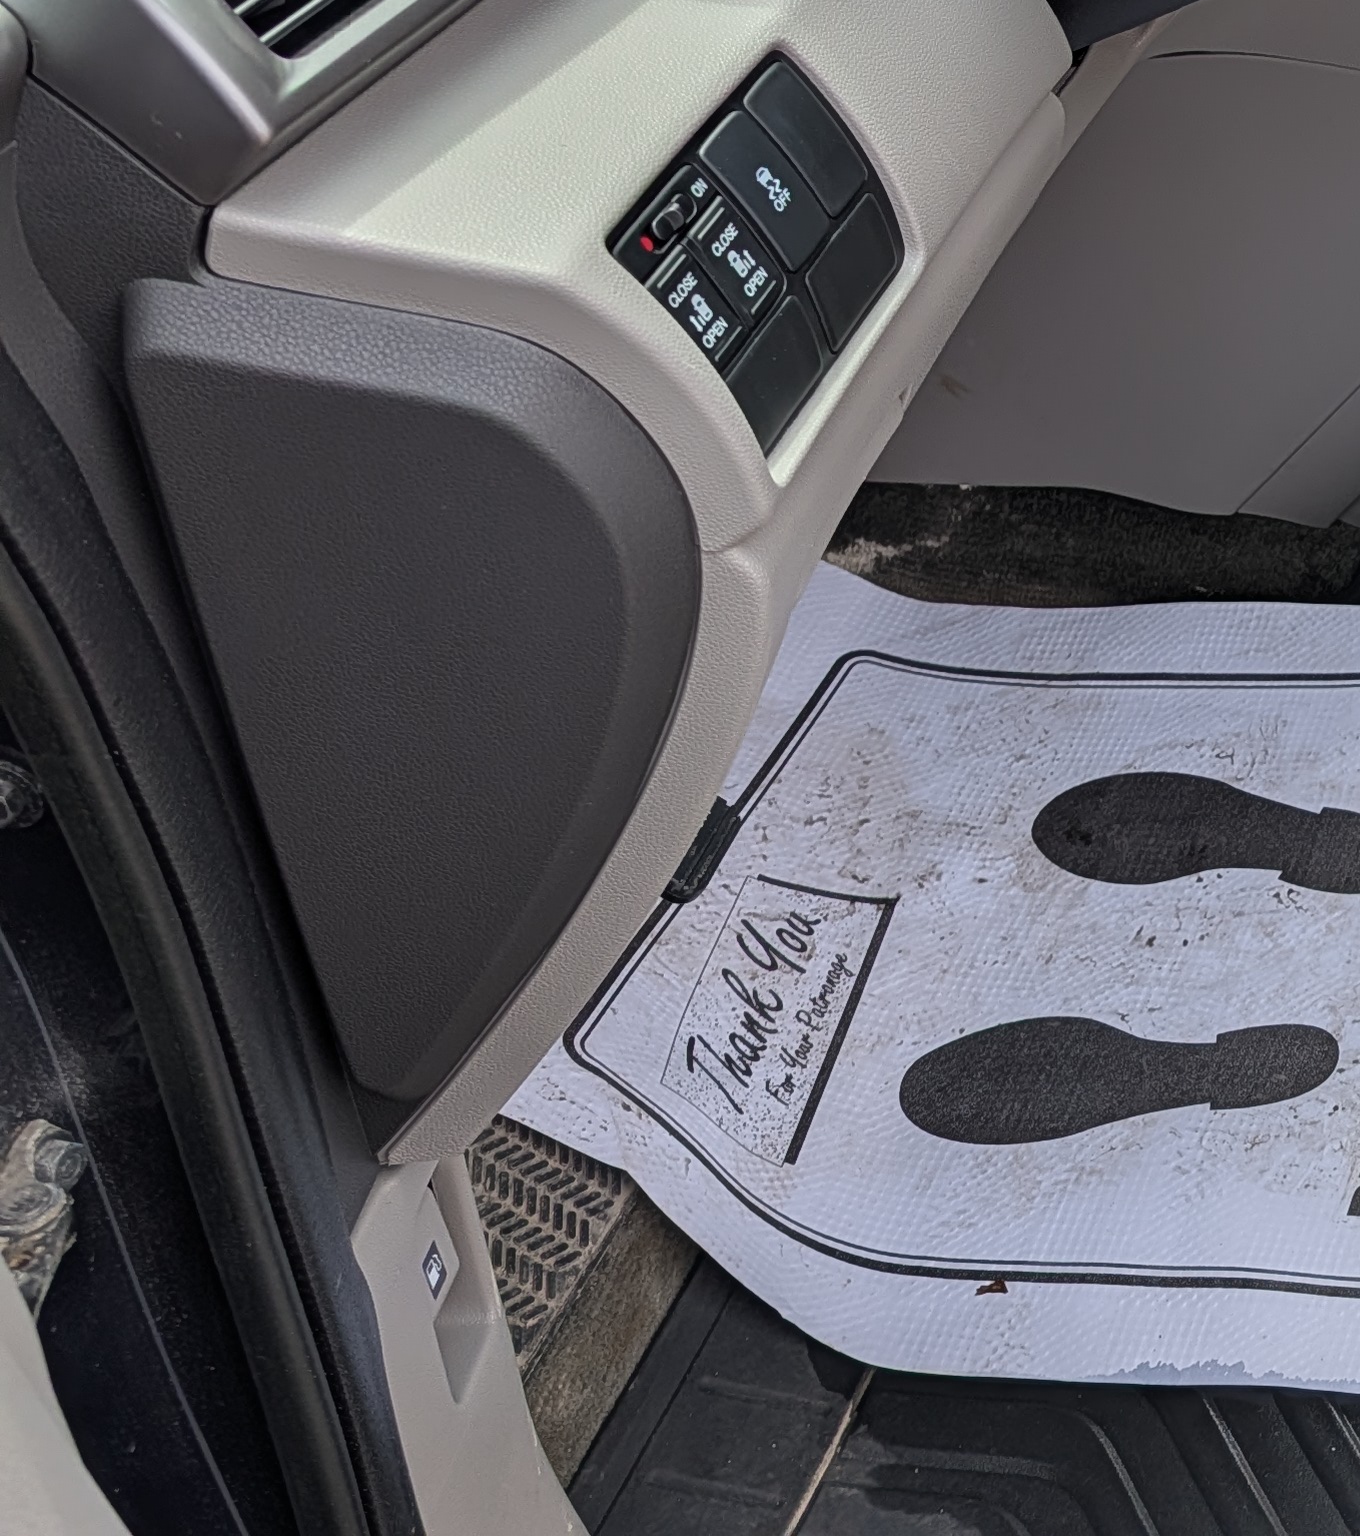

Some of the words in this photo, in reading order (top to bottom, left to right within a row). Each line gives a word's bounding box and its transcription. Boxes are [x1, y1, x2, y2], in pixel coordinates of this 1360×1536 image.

[690, 177, 709, 199] ON
[773, 188, 793, 213] OFF
[711, 221, 740, 258] CLOSE
[667, 271, 698, 308] CLOSE
[743, 266, 769, 297] OPEN
[702, 315, 729, 349] OPEN
[795, 951, 857, 1033] Patronage
[686, 967, 784, 1115] Thank
[736, 911, 822, 975] You
[779, 1032, 815, 1069] Your
[764, 1072, 797, 1106] For
